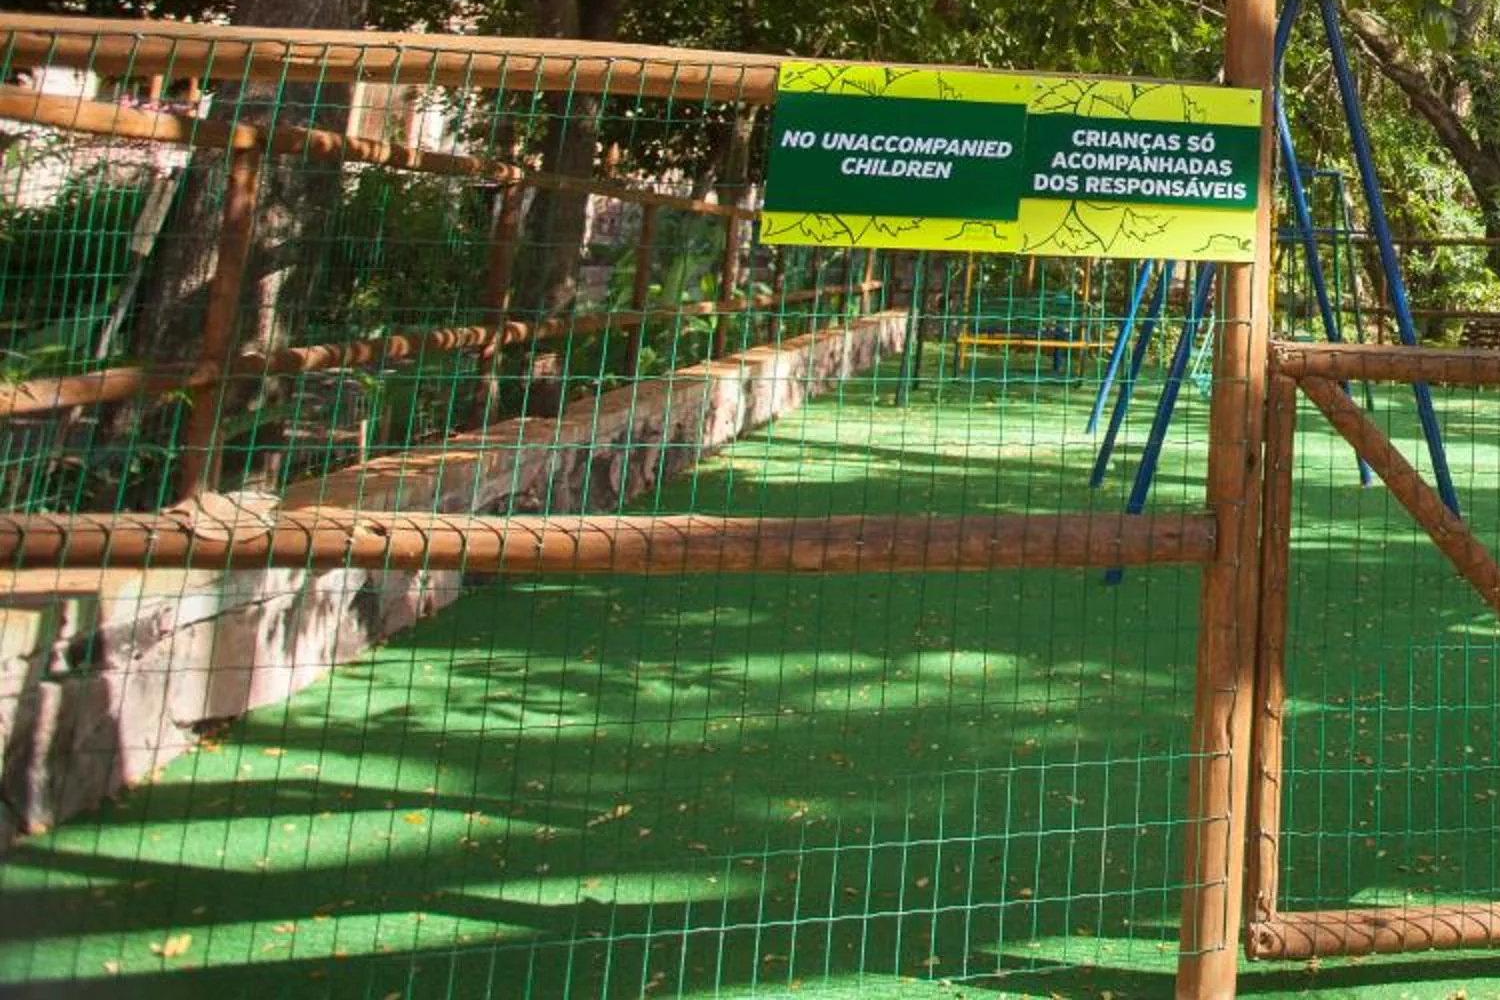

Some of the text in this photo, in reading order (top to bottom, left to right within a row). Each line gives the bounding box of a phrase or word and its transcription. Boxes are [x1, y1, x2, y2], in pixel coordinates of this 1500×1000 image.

[780, 130, 1012, 159] NO UNACCOMPANIED
[1072, 129, 1215, 154] CRIANÇAS SÓ
[841, 157, 952, 179] CHILDREN
[1051, 152, 1232, 176] ACOMPANHADAS
[1033, 174, 1247, 200] DOS RESPONSÁVEIS
